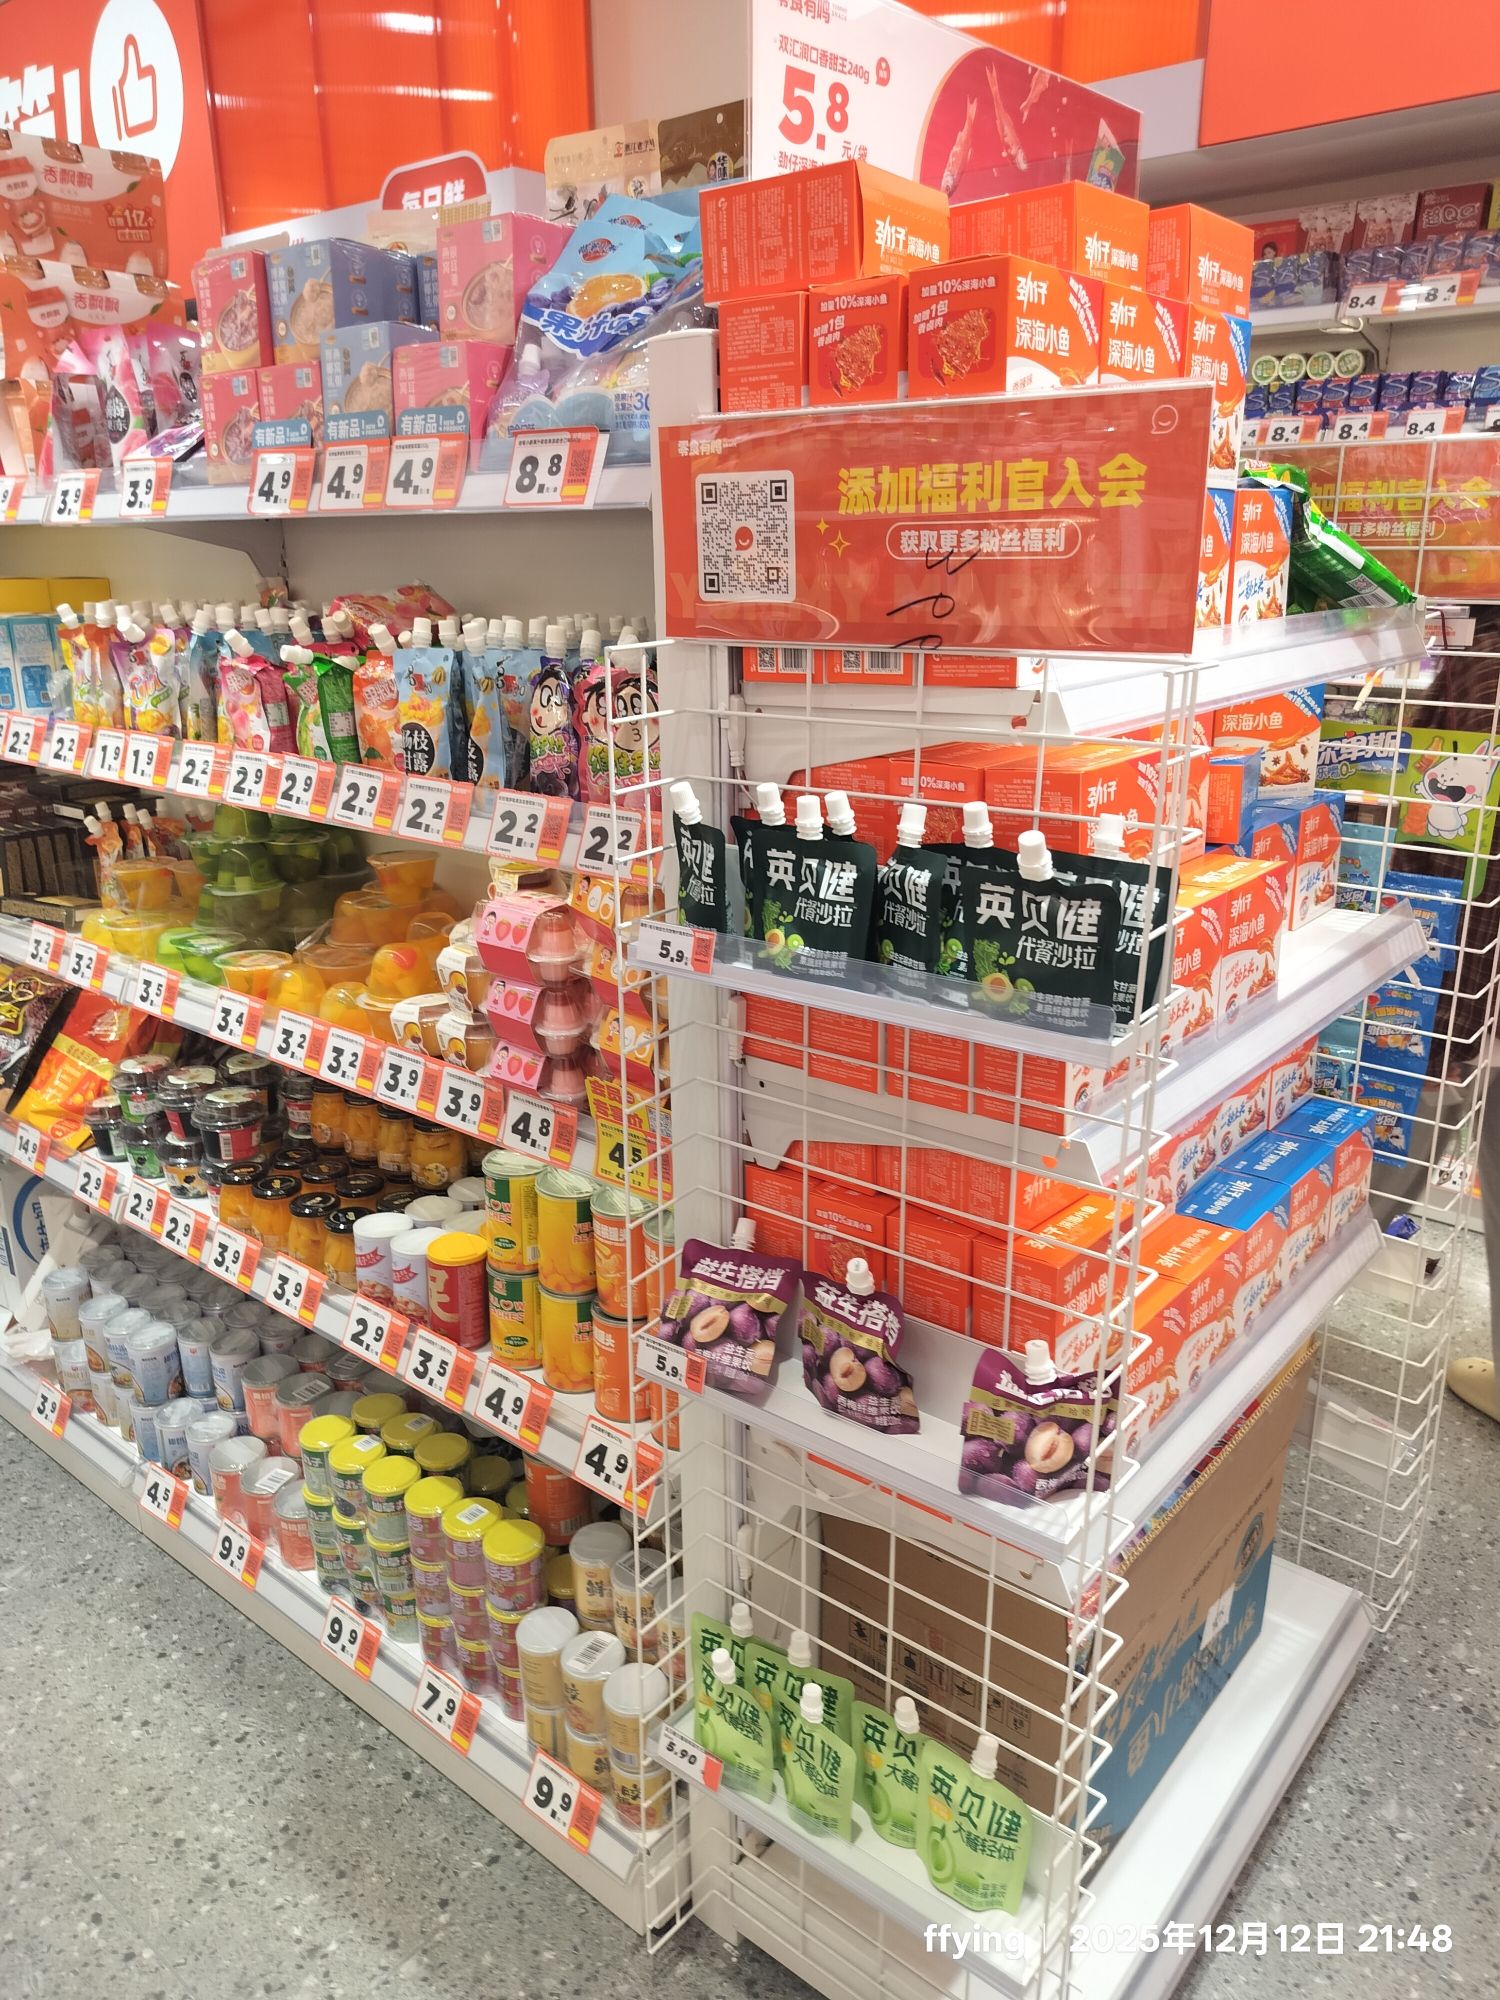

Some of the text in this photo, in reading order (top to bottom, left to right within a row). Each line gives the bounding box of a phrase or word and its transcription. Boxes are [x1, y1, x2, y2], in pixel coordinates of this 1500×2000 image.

[778, 34, 870, 85] 双汇润口香甜王240g
[778, 64, 850, 151] 5.8
[875, 215, 941, 264] 劲仔 深海小鱼
[1085, 232, 1139, 272] 劲仔 深海小鱼
[1016, 271, 1049, 313] 劲仔
[1347, 291, 1376, 308] 8.4
[1109, 296, 1138, 336] 劲仔
[1193, 314, 1217, 351] 劲仔
[1014, 317, 1071, 358] 深海小鱼
[1107, 337, 1156, 375] 深海小鱼
[1191, 353, 1229, 387] 深海小鱼
[1272, 426, 1299, 442] 8.4
[1337, 423, 1368, 440] 8.4
[1406, 419, 1435, 435] 8.4
[258, 471, 290, 503] 4.9
[327, 464, 363, 499] 4.9
[393, 454, 433, 494] 4.9
[516, 454, 562, 493] 8.8
[837, 452, 1148, 516] 添加福利官入会
[57, 489, 80, 515] 3.9
[127, 479, 152, 508] 3.9
[1311, 475, 1492, 514] 加福利官入会
[1242, 498, 1263, 527] 劲仔
[899, 525, 1066, 555] 获取更多粉丝福利
[1240, 531, 1275, 555] 深海小鱼
[1221, 711, 1284, 732] 深海小鱼
[9, 731, 30, 754] 2.2
[55, 732, 74, 761] 2.2
[101, 745, 120, 771] 1.9
[133, 744, 153, 776] 1.9
[182, 759, 209, 786] 2.2
[233, 767, 262, 796] 2.9
[281, 769, 312, 804] 2.9
[340, 779, 377, 816] 2.9
[1087, 778, 1118, 816] 劲仔
[406, 799, 444, 832] 2.2
[495, 810, 538, 847] 2.2
[584, 826, 632, 865] 2.2
[766, 848, 859, 904] 英贝健
[794, 896, 855, 928] 代餐沙拉
[884, 899, 928, 938] 代餐沙拉
[976, 882, 1102, 944] 英贝健
[1230, 891, 1253, 923] 劲仔
[1228, 913, 1266, 950] 深海小鱼
[72, 953, 92, 978] 3.2
[659, 940, 684, 962] 5.9
[1016, 934, 1098, 970] 代餐沙拉
[140, 979, 163, 1006] 3.5
[216, 1007, 244, 1037] 3.4
[276, 1028, 306, 1062] 3.2
[327, 1046, 358, 1080] 3.2
[384, 1059, 418, 1097] 3.9
[443, 1084, 482, 1125] 3.9
[512, 1109, 550, 1148] 4.8
[18, 1135, 37, 1162] 14.9
[78, 1172, 101, 1199] 2.9
[130, 1193, 153, 1220] 2.9
[164, 1217, 190, 1245] 2.9
[212, 1239, 240, 1274] 3.9
[691, 1256, 785, 1292] 益生搭档
[271, 1273, 302, 1308] 3.9
[815, 1280, 902, 1348] 益生搭档
[348, 1318, 384, 1352] 2.9
[412, 1347, 448, 1388] 3.5
[656, 1355, 678, 1377] 5.9
[37, 1394, 56, 1419] 3.9
[484, 1387, 523, 1426] 4.9
[584, 1444, 628, 1485] 4.9
[147, 1482, 170, 1508] 4.5
[219, 1536, 244, 1567] 9.9
[327, 1617, 357, 1652] 9.9
[422, 1682, 455, 1723] 7.9
[665, 1741, 697, 1766] 5.90
[781, 1700, 842, 1785] 英贝健
[863, 1713, 917, 1767] 英贝
[533, 1776, 571, 1819] 9.9
[930, 1764, 1023, 1843] 英贝健
